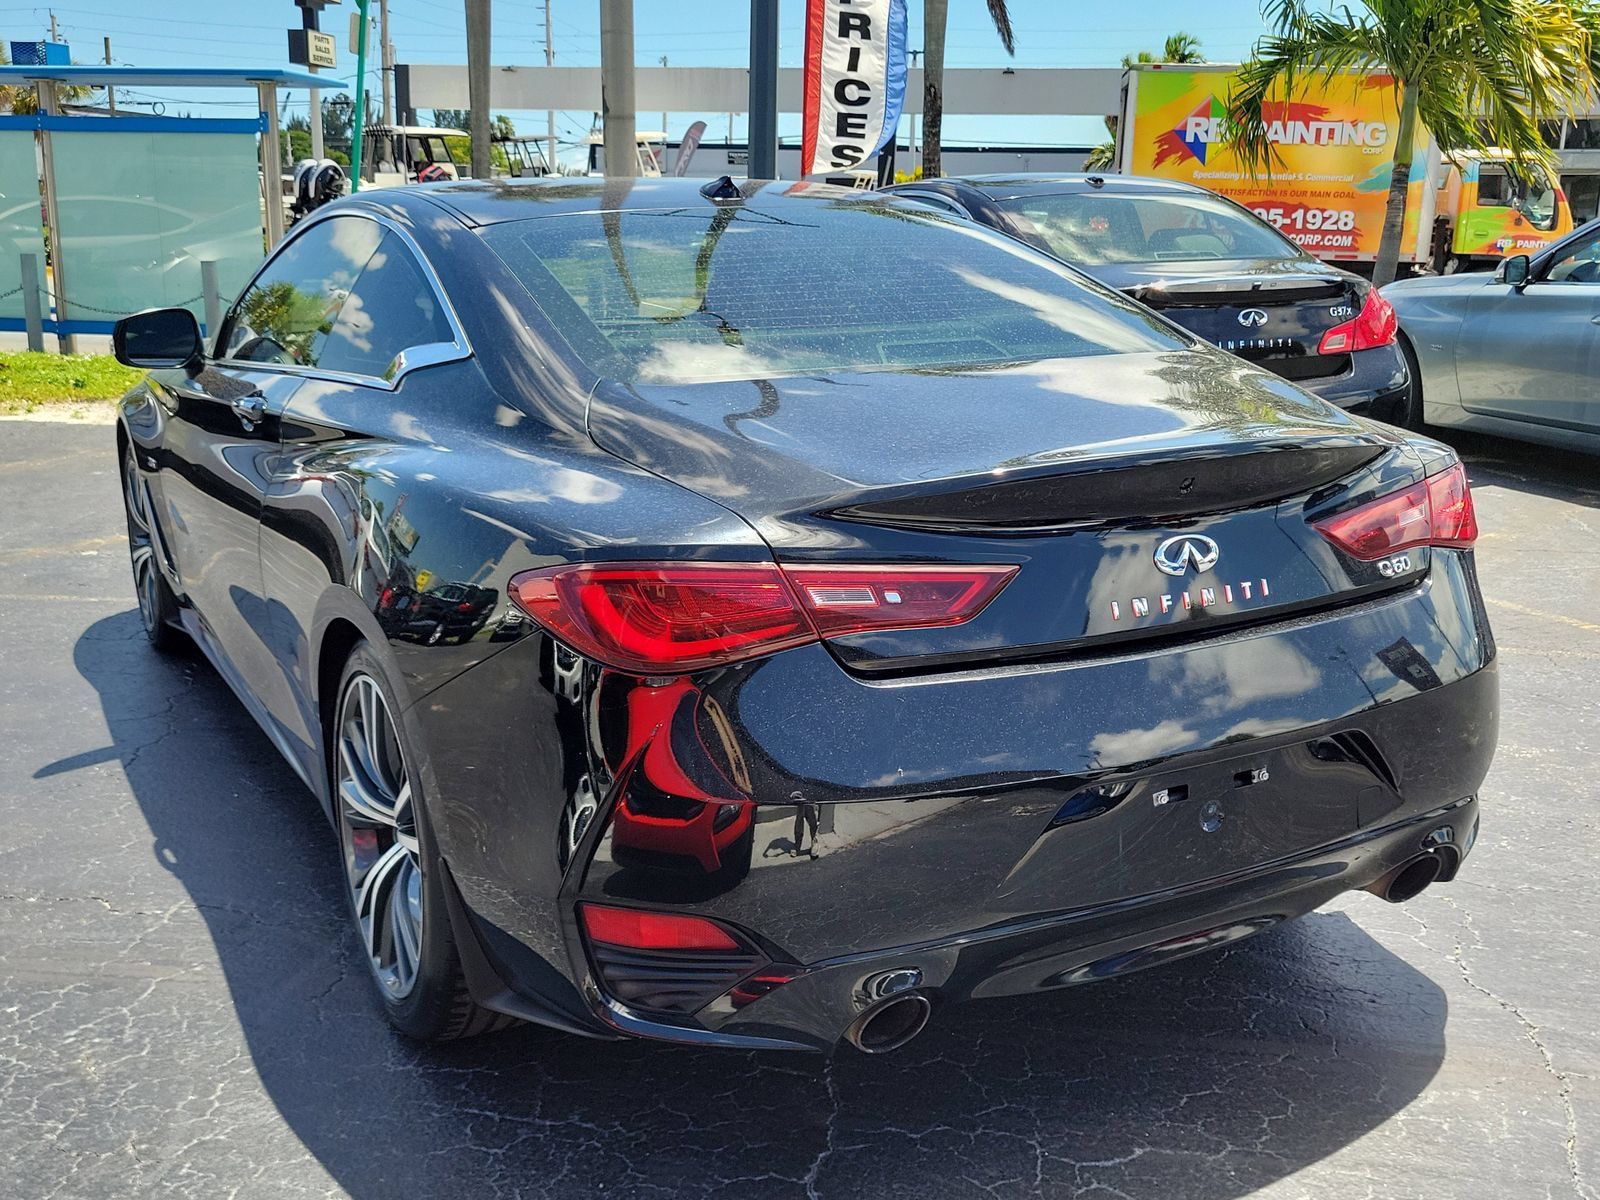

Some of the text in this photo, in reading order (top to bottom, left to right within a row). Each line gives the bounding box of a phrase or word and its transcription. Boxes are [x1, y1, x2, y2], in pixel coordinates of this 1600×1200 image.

[314, 35, 329, 44] PARTS
[315, 45, 330, 54] SALES
[312, 54, 333, 65] SERVICE
[830, 0, 871, 168] RICES
[1192, 170, 1240, 181] Specializing
[1305, 173, 1354, 182] Commercial
[1290, 190, 1308, 198] OUR
[1333, 191, 1356, 199] GOAL
[1218, 338, 1292, 350] INFINITI
[1378, 556, 1410, 577] Q60
[1111, 578, 1270, 621] INFINITI
